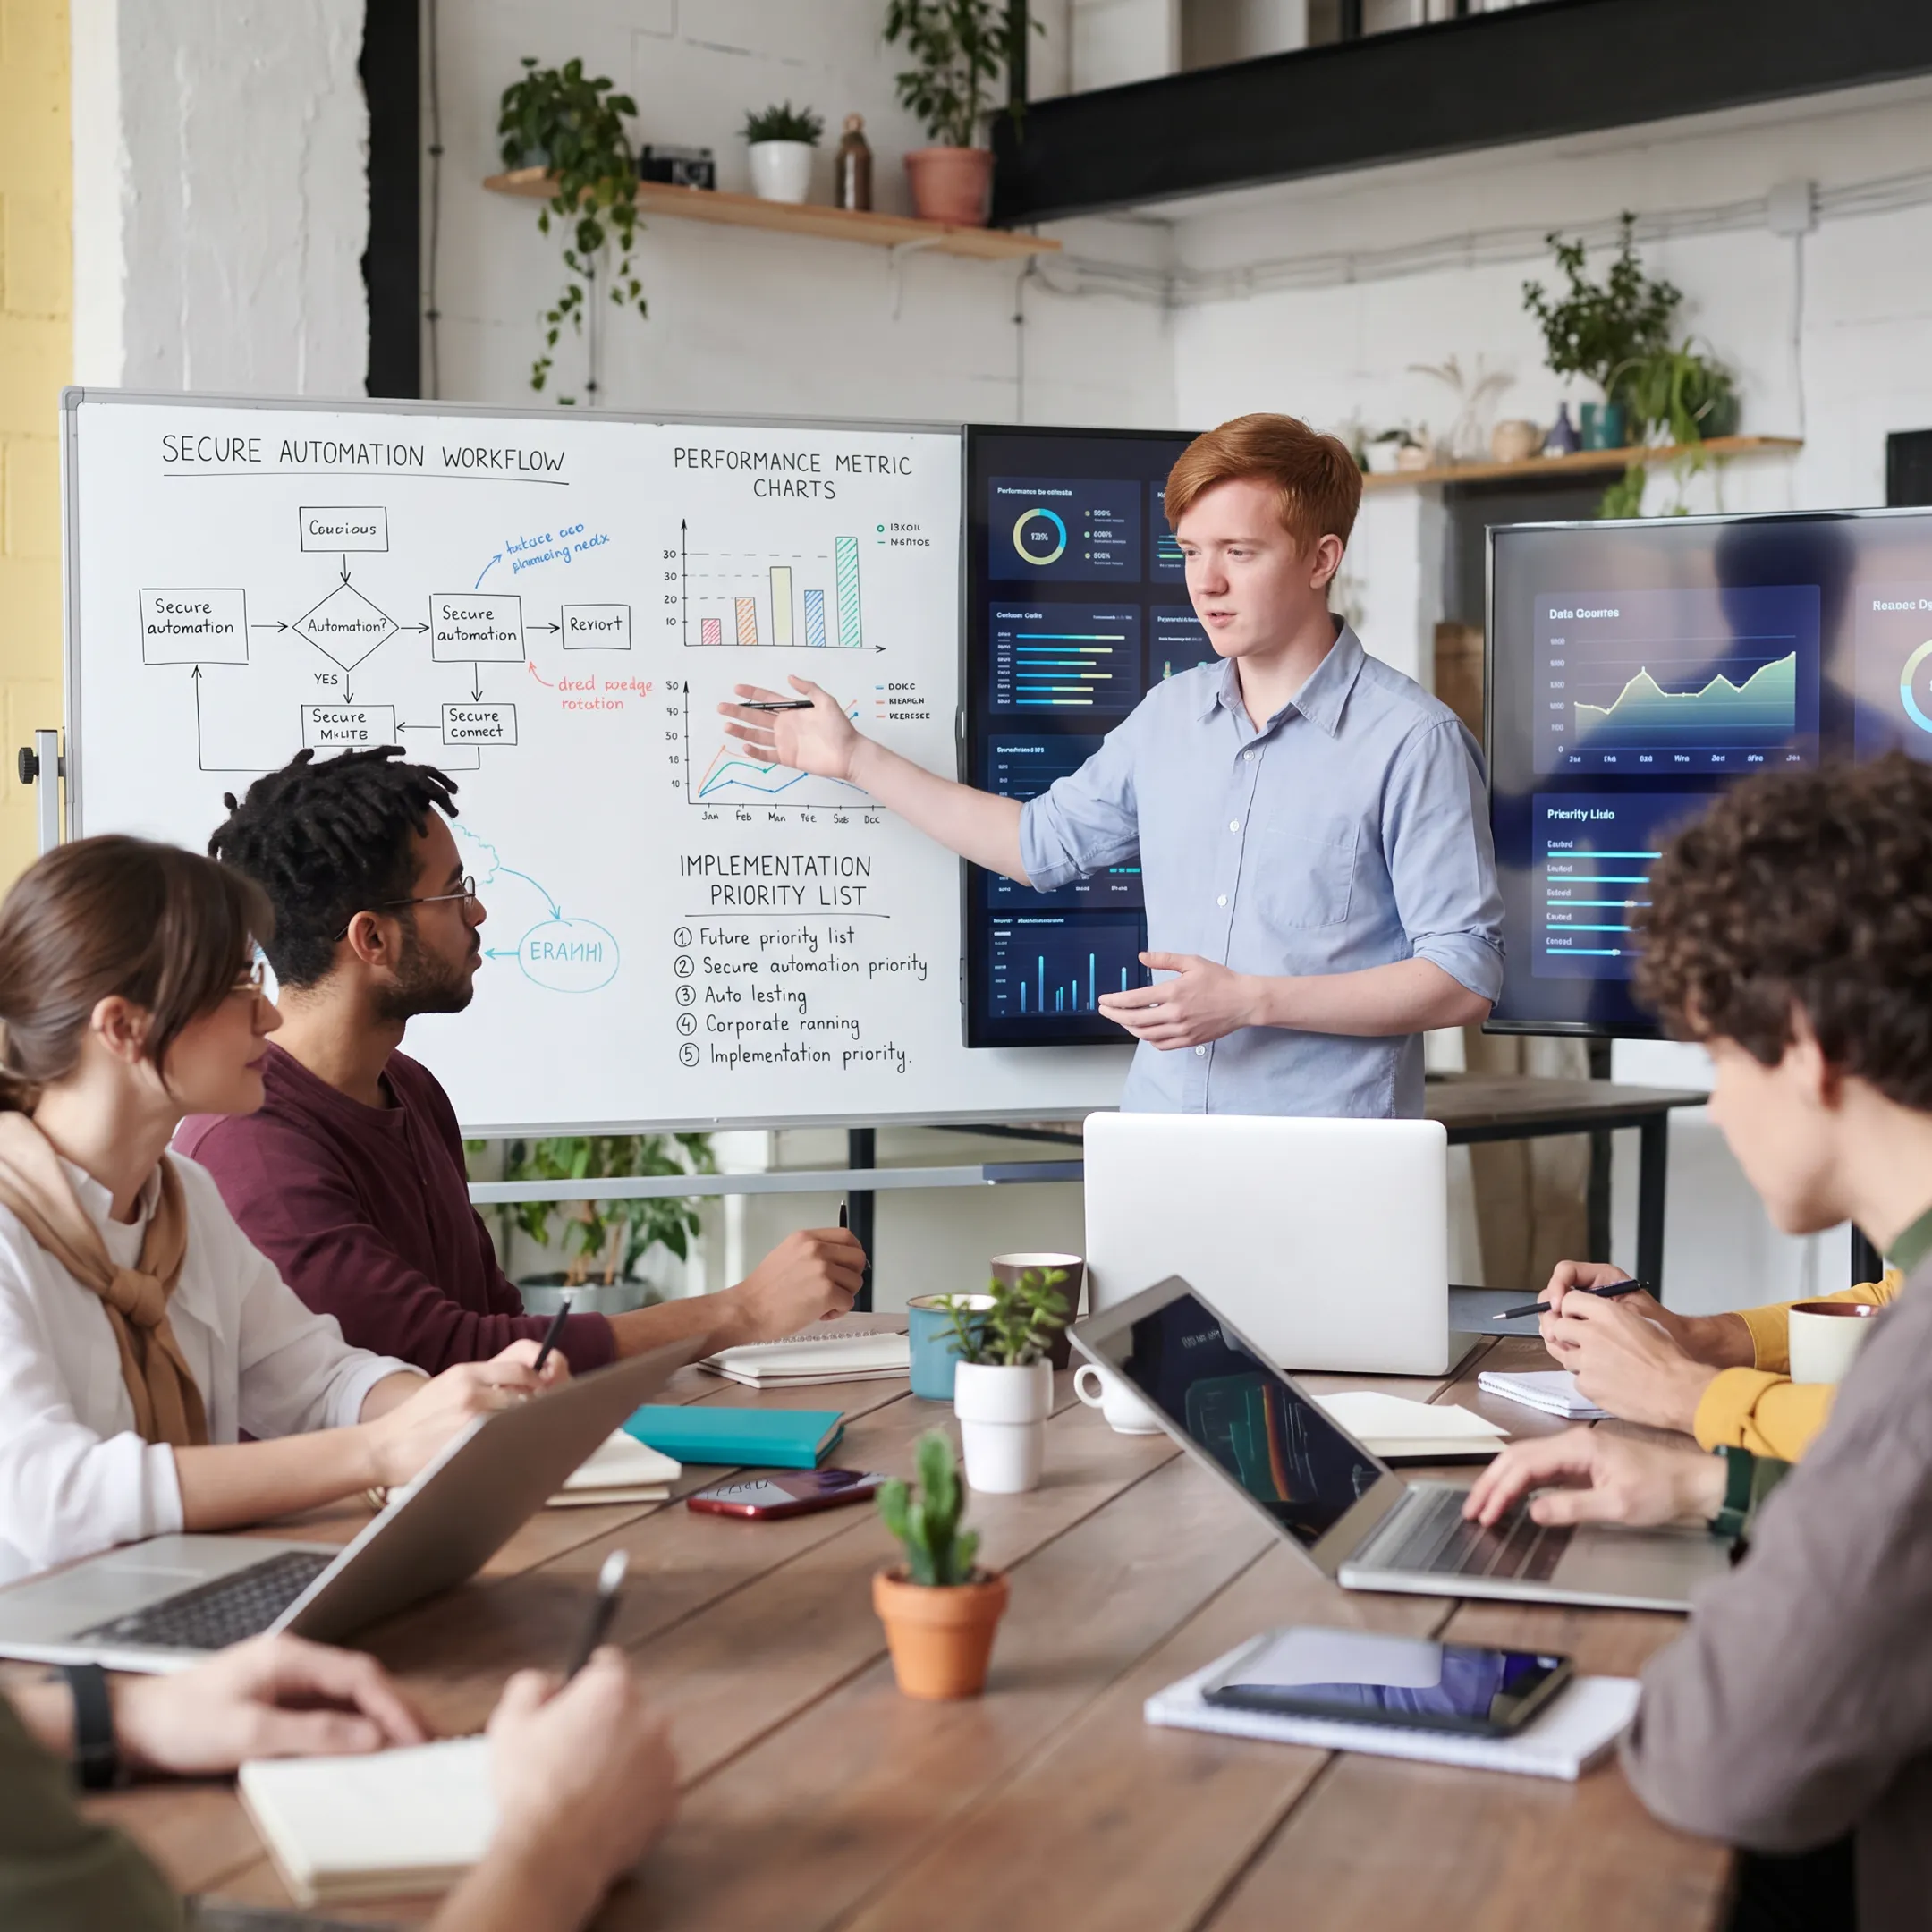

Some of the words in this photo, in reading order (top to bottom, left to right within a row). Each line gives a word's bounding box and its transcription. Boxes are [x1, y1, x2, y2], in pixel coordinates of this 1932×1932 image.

[162, 434, 262, 462] SECURE
[279, 439, 424, 467] AUTOMATION
[442, 446, 565, 471] WORKFLOW
[674, 447, 821, 473] PERFORMANCE
[835, 454, 912, 476] METRIC
[753, 478, 836, 500] CHARTS
[663, 549, 677, 560] 30
[664, 572, 678, 581] 30
[155, 597, 212, 614] Secure
[664, 594, 678, 605] 20
[442, 604, 495, 621] Secure
[1549, 609, 1573, 619] Data
[147, 618, 234, 635] automation
[307, 617, 387, 633] Automation?
[665, 617, 677, 626] 10
[437, 625, 517, 641] automation
[313, 673, 338, 685] YES
[312, 708, 367, 724] Secure
[449, 708, 499, 723] Secure
[450, 723, 504, 738] connect
[680, 854, 871, 877] IMPLEMENTATION
[710, 884, 806, 906] PRIORITY
[819, 886, 867, 906] LIST
[699, 927, 750, 945] Future
[759, 925, 818, 953] priority
[828, 925, 855, 944] list
[703, 956, 758, 975] Secure
[770, 953, 860, 973] automation
[869, 953, 928, 982] priority
[704, 985, 741, 1004] Auto
[751, 984, 808, 1015] lesting
[706, 1013, 790, 1040] Corporate
[800, 1013, 860, 1041] ranning
[710, 1041, 831, 1071] Implementation
[843, 1040, 912, 1074] priority.
